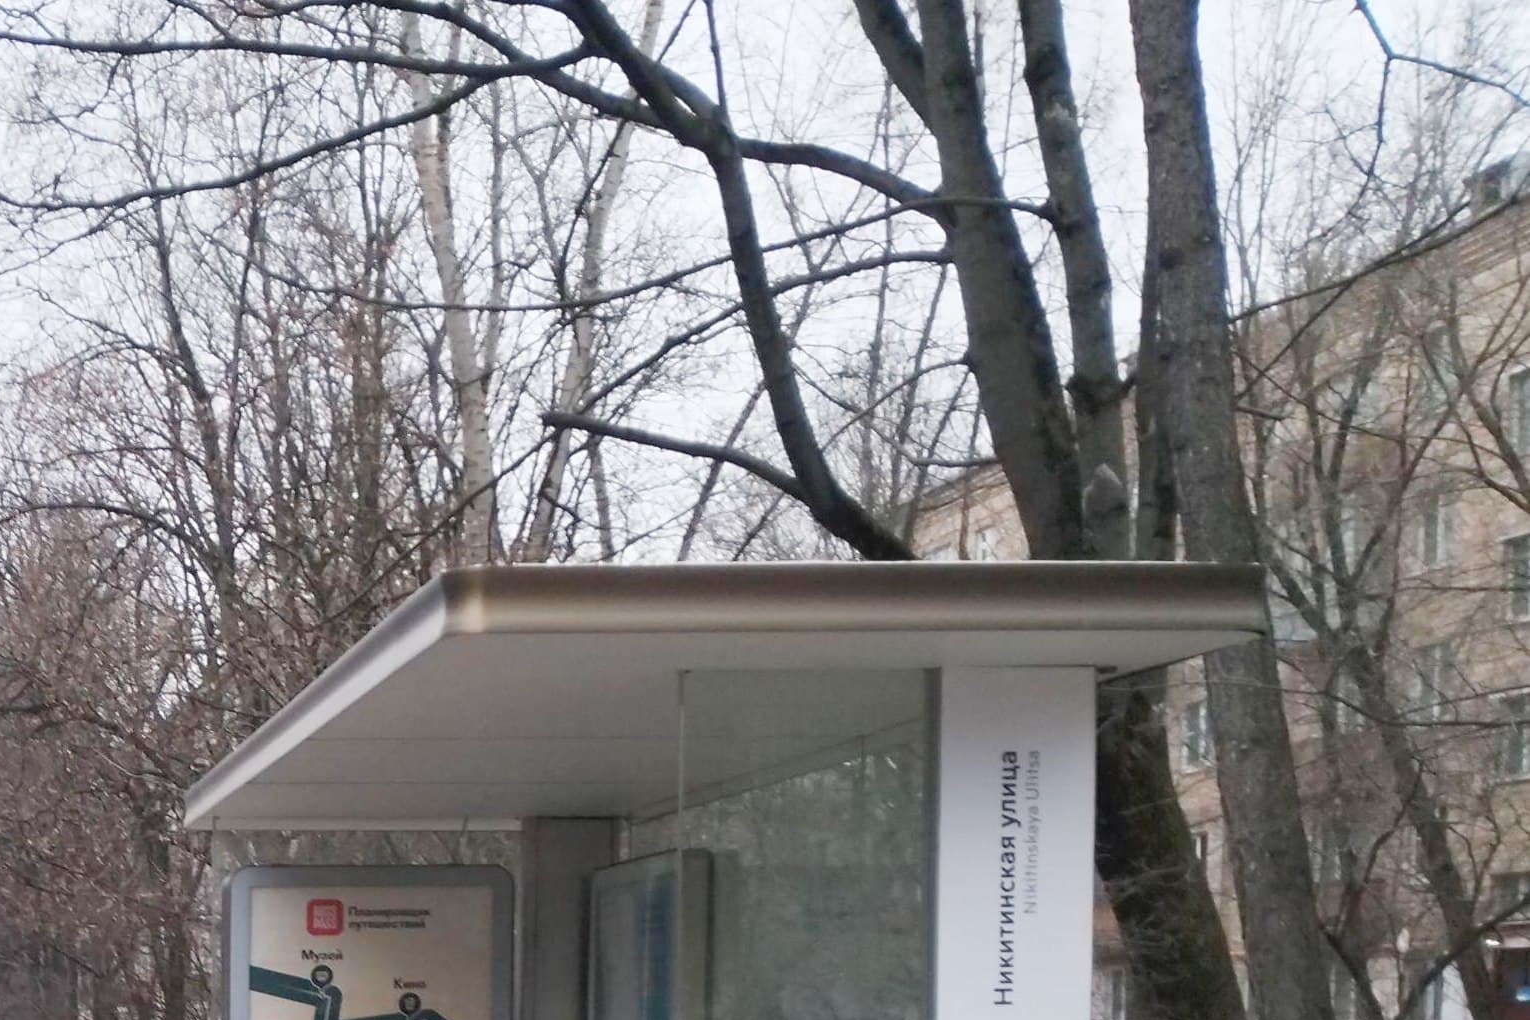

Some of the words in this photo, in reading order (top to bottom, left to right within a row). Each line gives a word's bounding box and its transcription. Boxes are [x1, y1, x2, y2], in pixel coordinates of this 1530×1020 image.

[1001, 751, 1022, 828] улица
[1024, 750, 1040, 800] Ulitsa
[1022, 805, 1041, 914] Nikitinskaya
[993, 835, 1016, 1005] Никитинская
[301, 949, 343, 962] Музей
[393, 977, 427, 989] Кино
